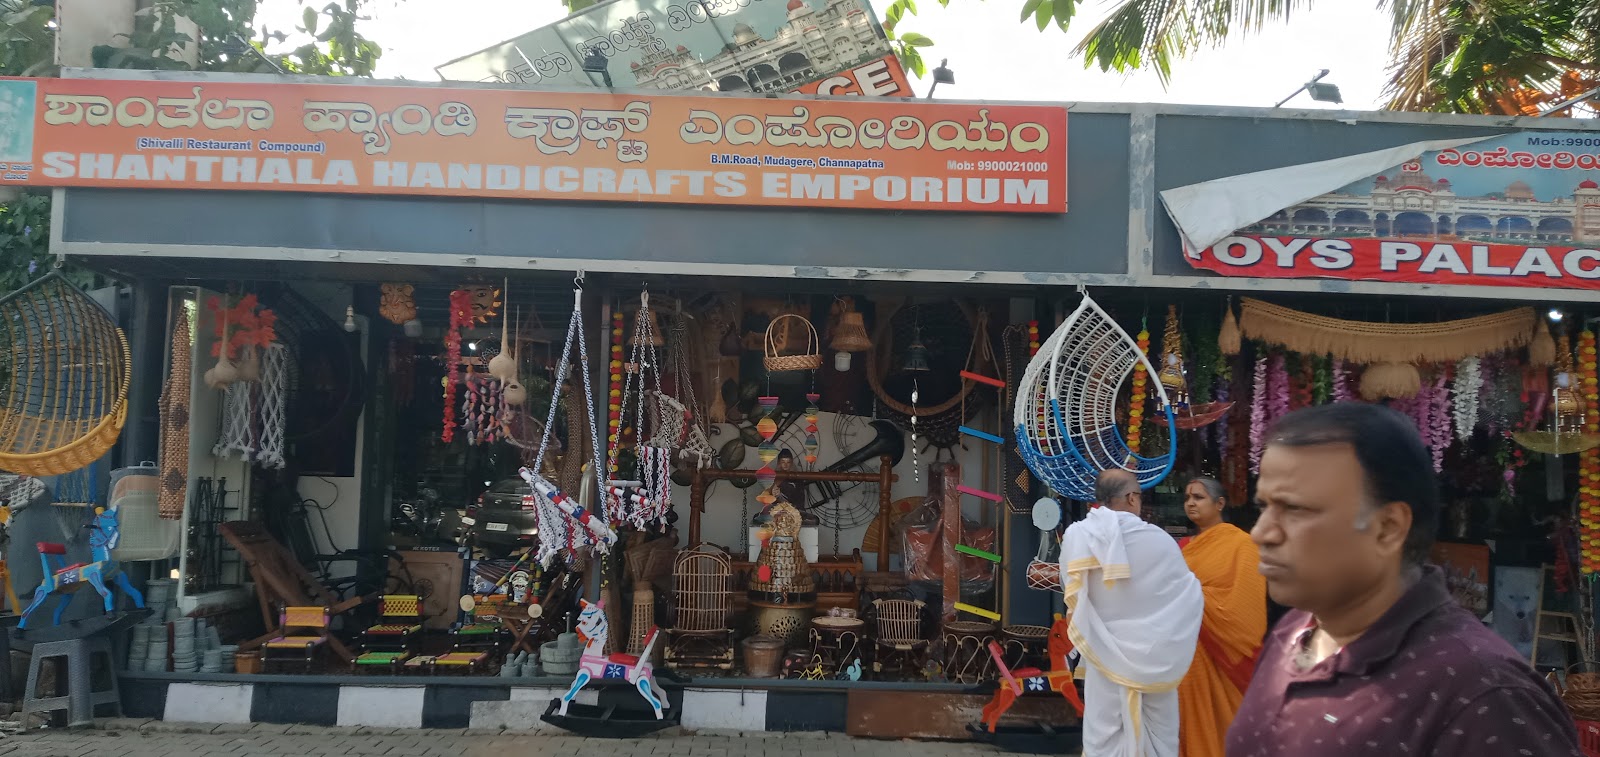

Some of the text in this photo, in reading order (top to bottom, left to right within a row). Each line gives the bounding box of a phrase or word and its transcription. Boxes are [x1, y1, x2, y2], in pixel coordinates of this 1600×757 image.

[43, 86, 275, 131] ಶಾಂತಲಾ
[303, 100, 478, 155] ಹ್ಯಾಂಡಿ
[504, 100, 651, 163] ಕ್ರಾಫ್ಟ್
[136, 137, 326, 154] (Shivalli Restaurant Compound)
[710, 153, 885, 170] B.M.Road, Mudagere, Channapatna
[947, 160, 1048, 172] Mob: 9900021000
[41, 151, 1049, 206] SHANTHALA HANDICRAFTS EMPORIUM
[1190, 236, 1354, 270] OYS
